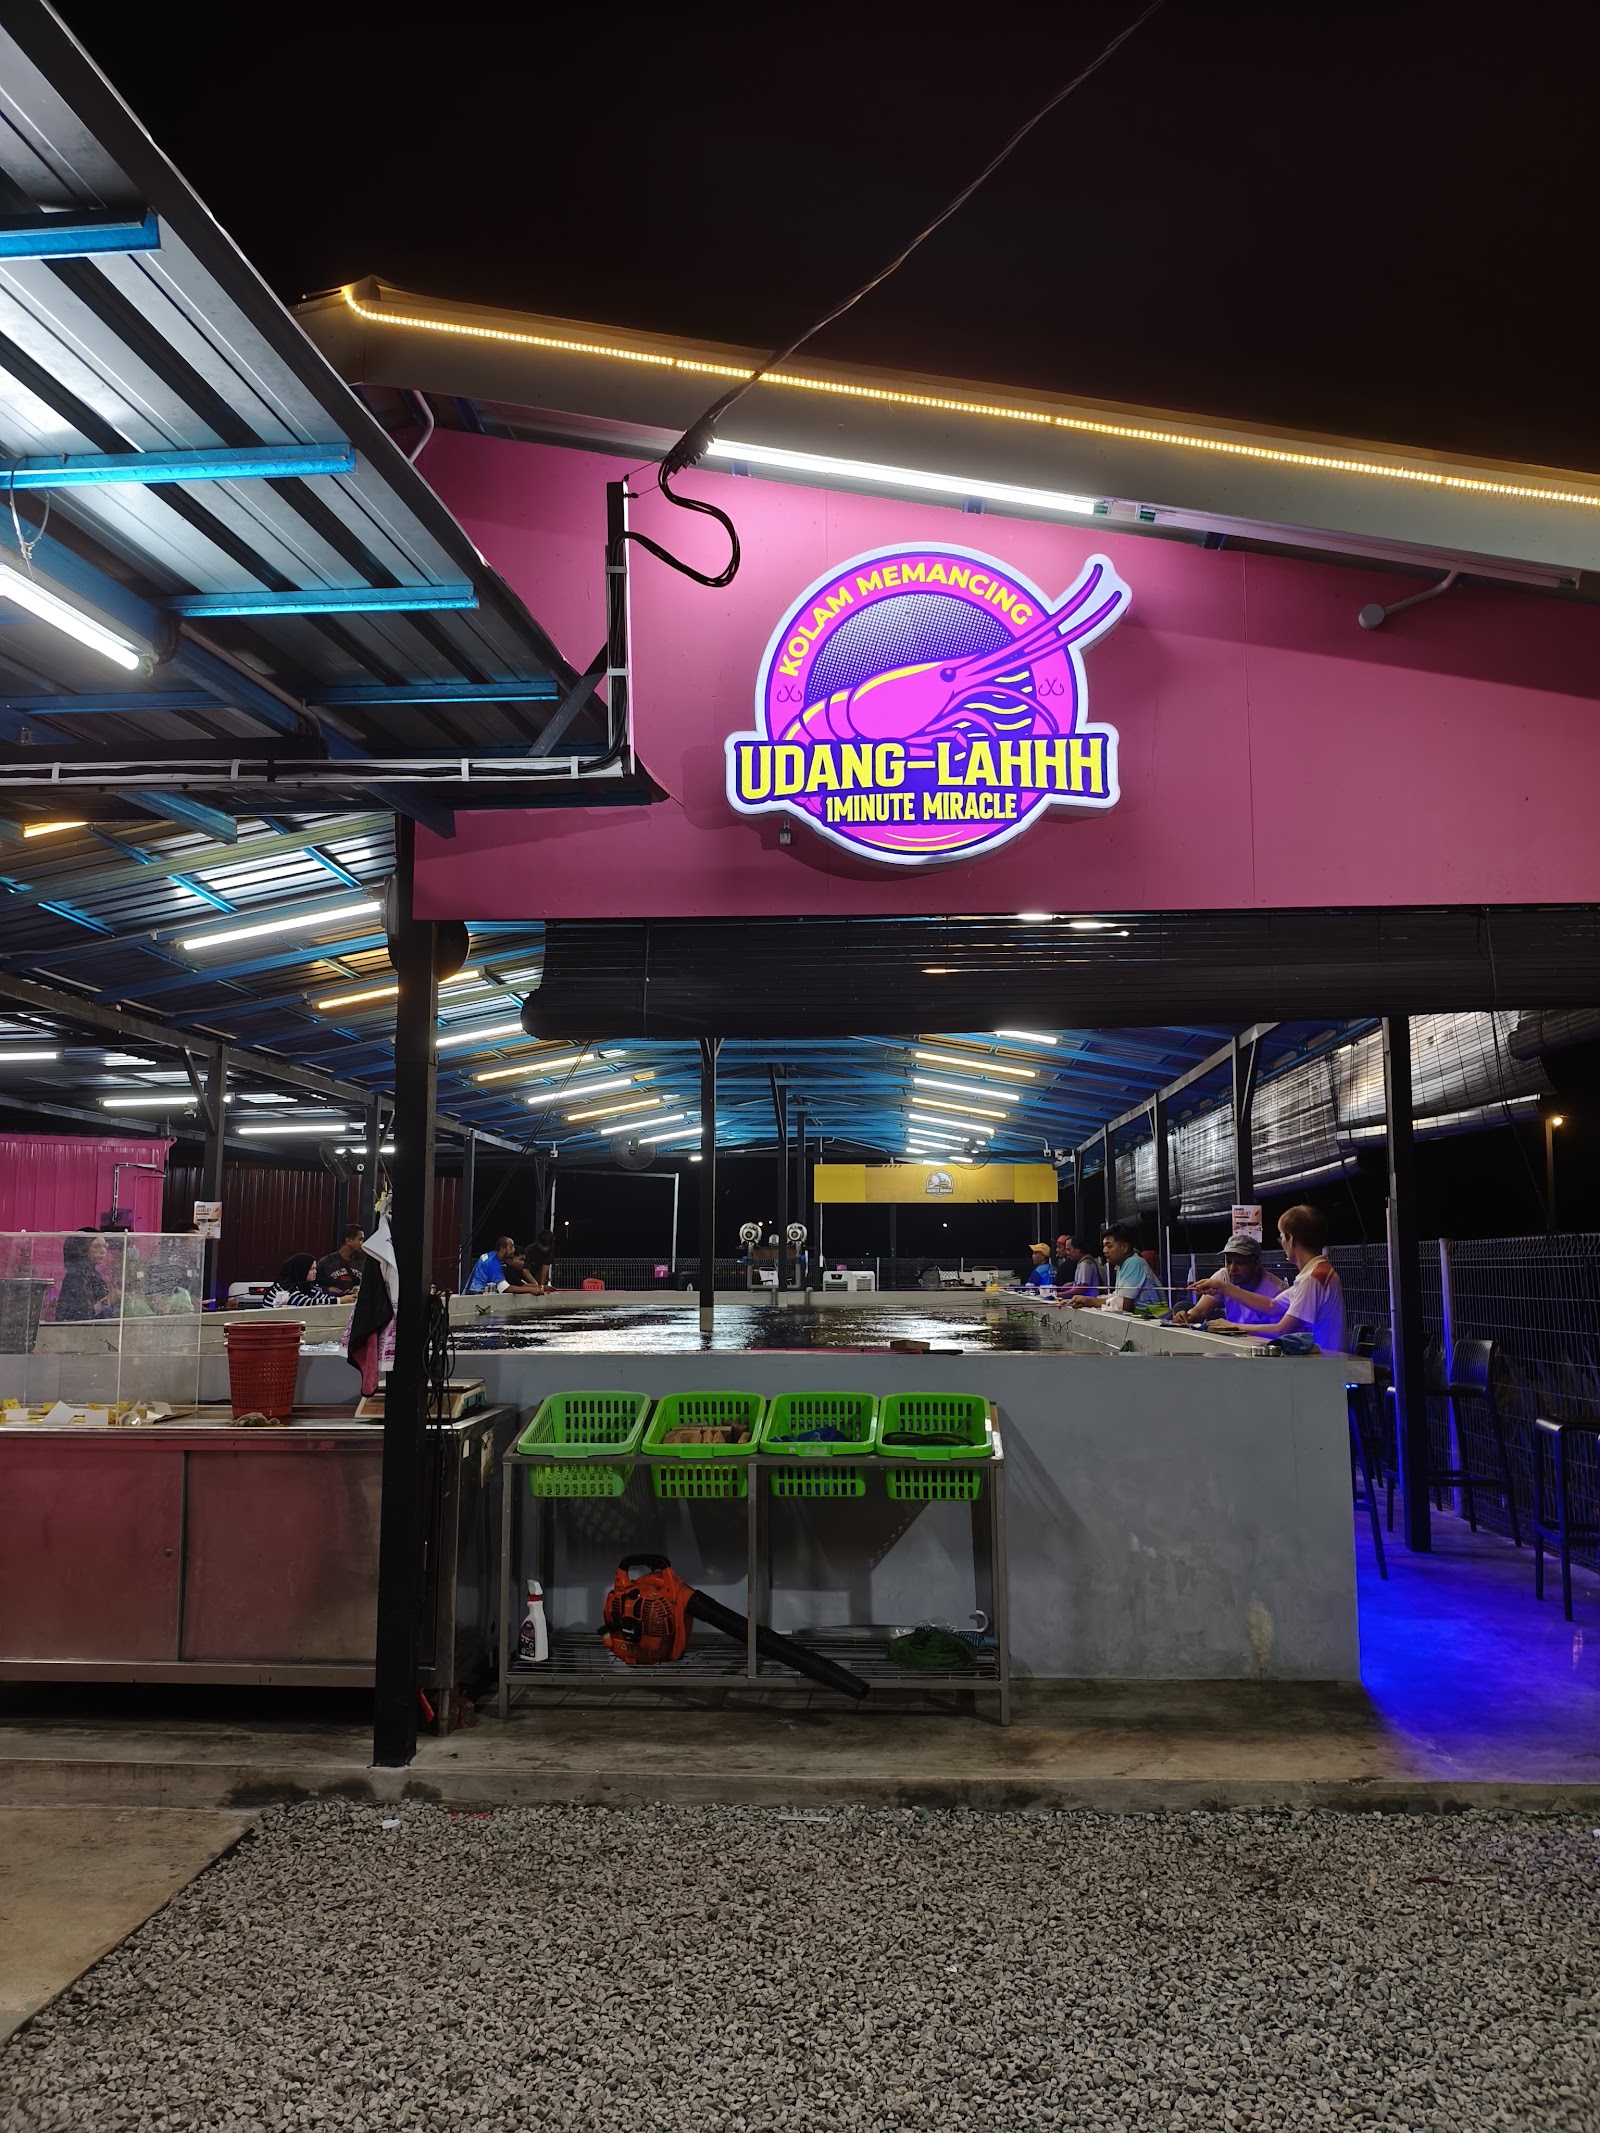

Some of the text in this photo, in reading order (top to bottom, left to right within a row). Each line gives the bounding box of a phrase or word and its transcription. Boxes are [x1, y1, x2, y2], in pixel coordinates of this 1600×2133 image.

[779, 563, 1033, 677] KOLAM MEMANCING
[740, 738, 1104, 800] UDANG-LAHHH
[826, 793, 1017, 823] 1MINUTE MIRACLE
